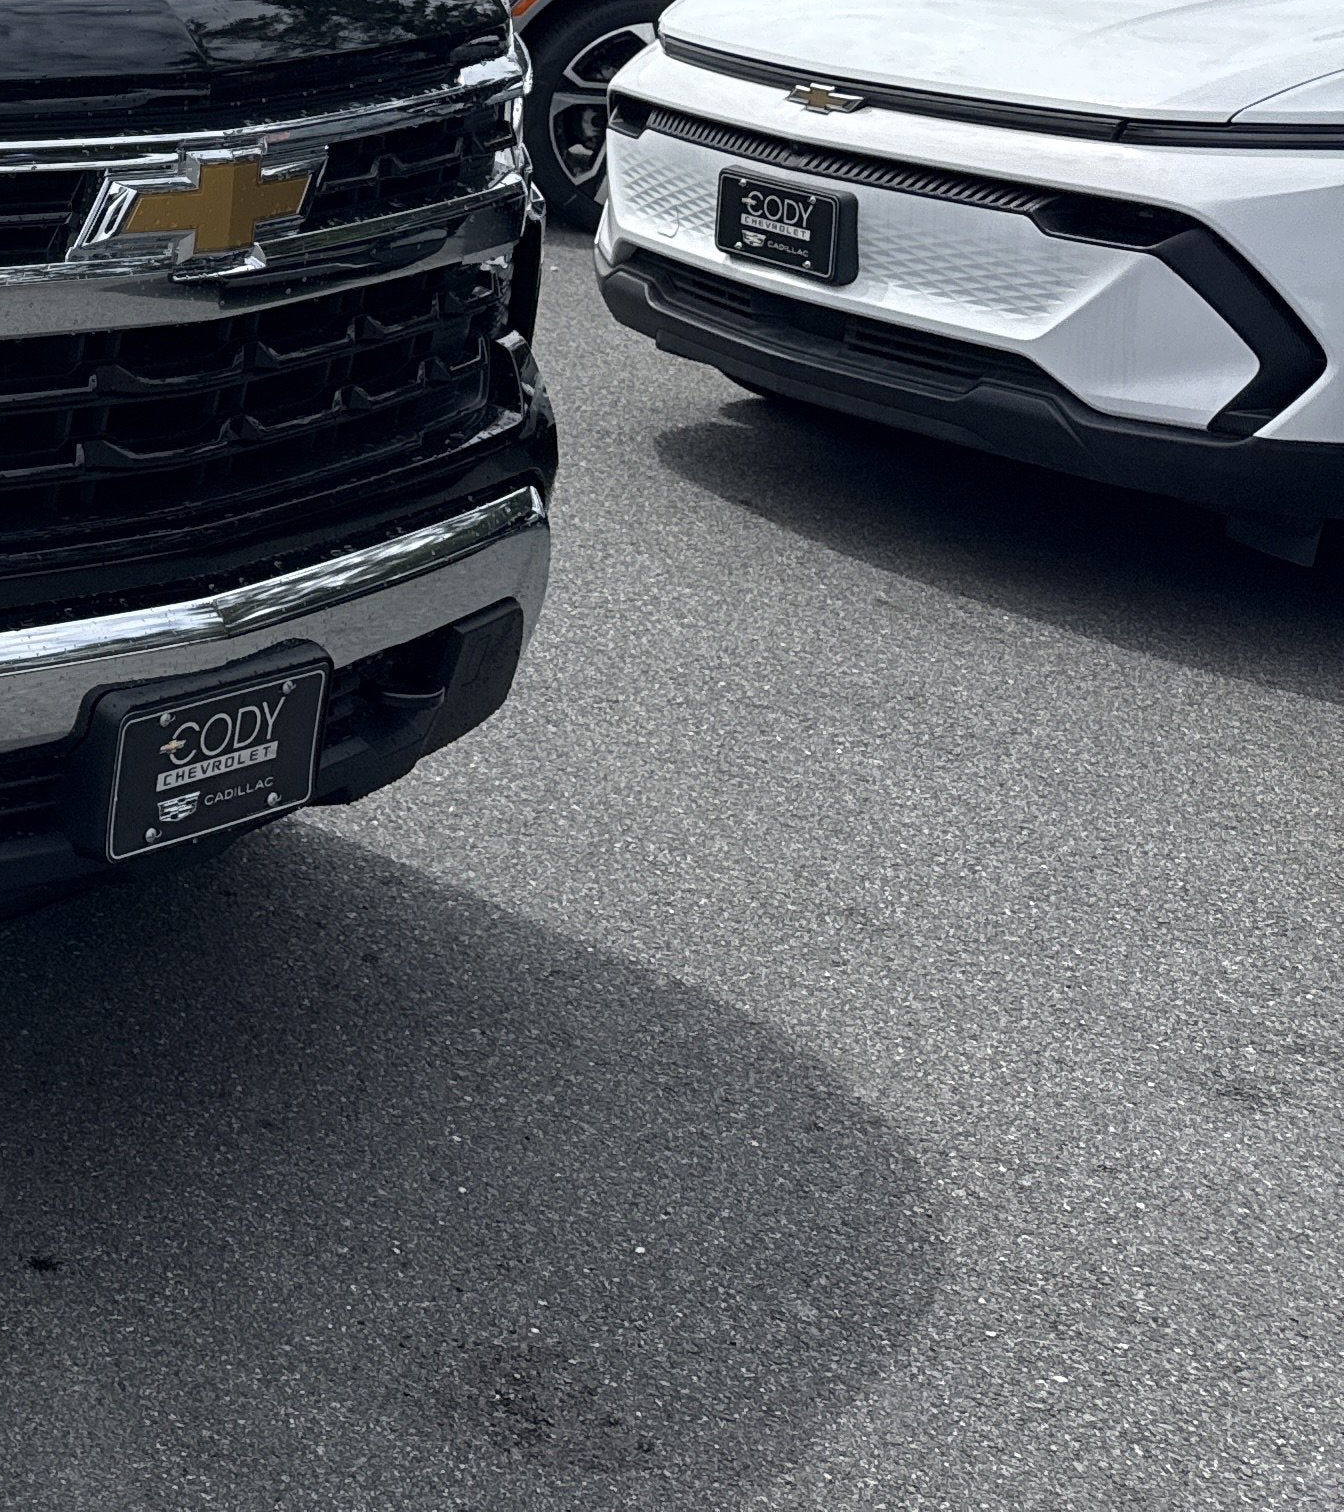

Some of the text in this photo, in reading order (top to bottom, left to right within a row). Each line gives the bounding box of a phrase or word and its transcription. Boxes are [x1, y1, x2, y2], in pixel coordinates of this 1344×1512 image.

[746, 190, 813, 228] CODY
[744, 215, 807, 239] CHEVROLET
[767, 240, 809, 258] CADILLAC
[169, 696, 286, 765] CODY
[162, 747, 272, 786] CHEVROLET
[204, 776, 274, 806] CADILLAC
